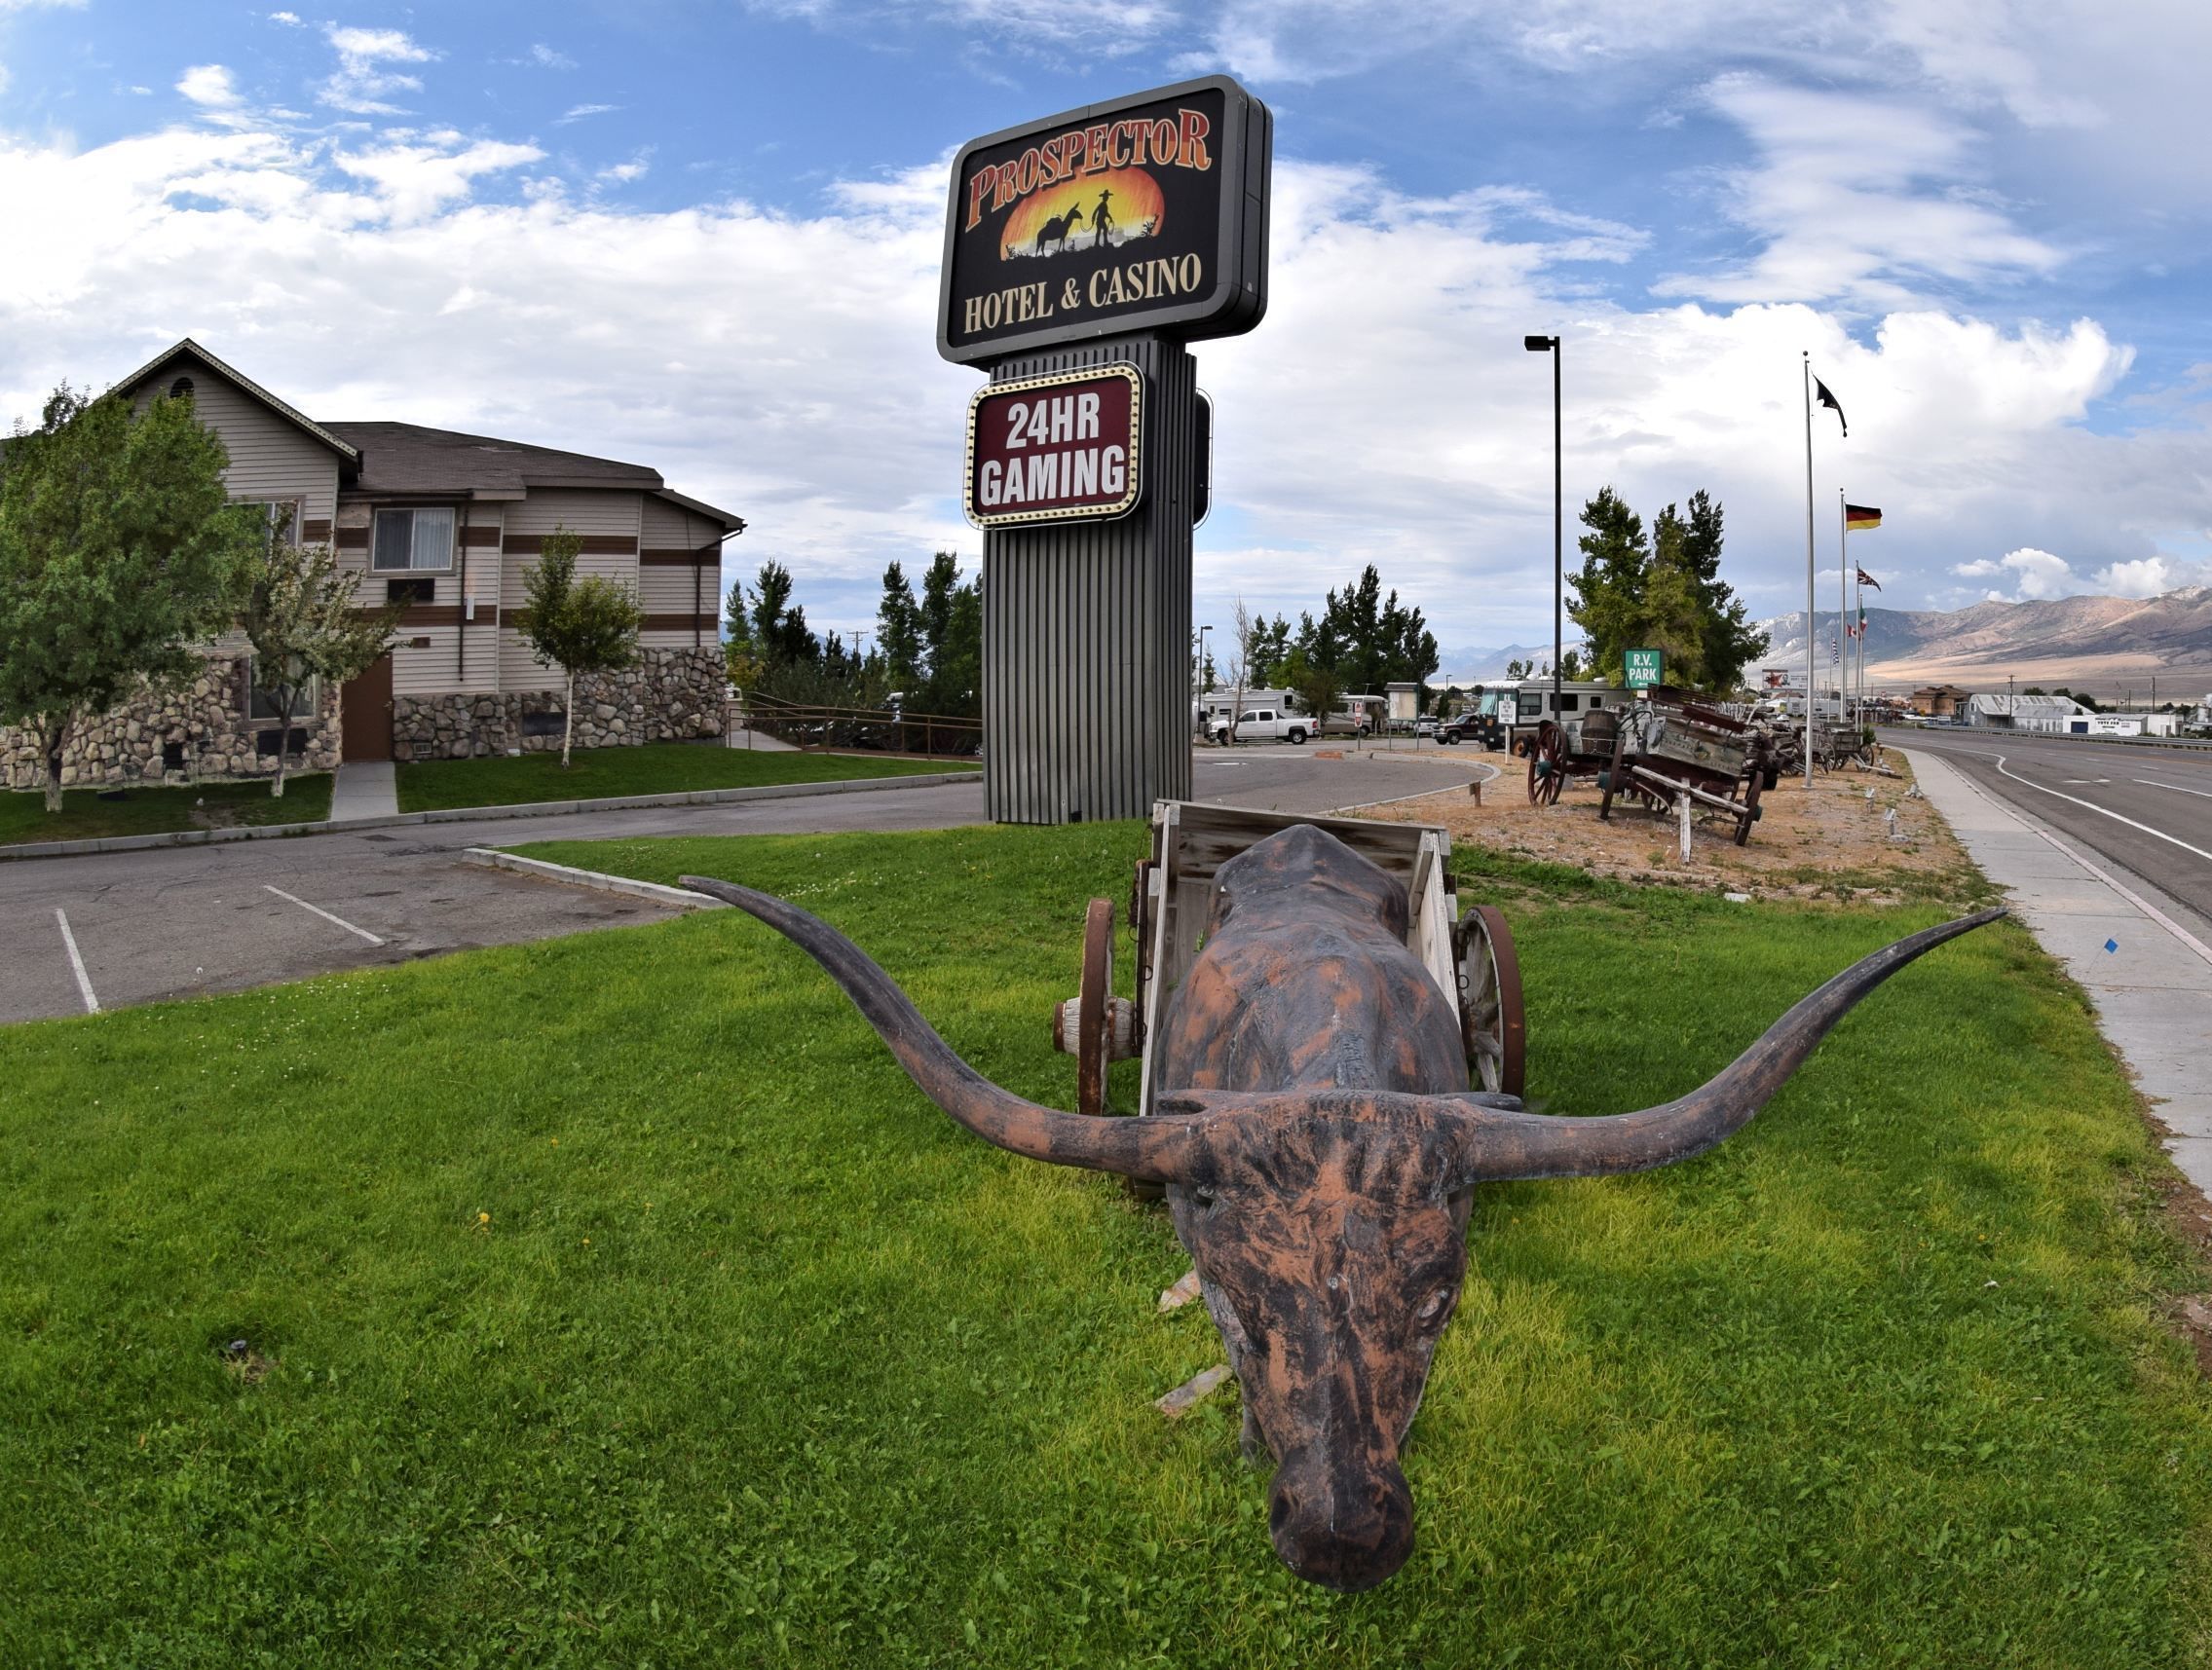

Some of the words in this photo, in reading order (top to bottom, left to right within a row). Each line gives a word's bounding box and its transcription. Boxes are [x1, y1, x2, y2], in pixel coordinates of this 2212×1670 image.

[965, 108, 1212, 233] PROSPECTOR
[963, 280, 1053, 334] HOTEL
[1061, 278, 1080, 310] &
[1089, 252, 1201, 308] CASINO
[1006, 392, 1100, 449] 24HR
[980, 445, 1124, 505] GAMING
[1629, 668, 1657, 681] PARK
[1633, 653, 1652, 666] R.V.
